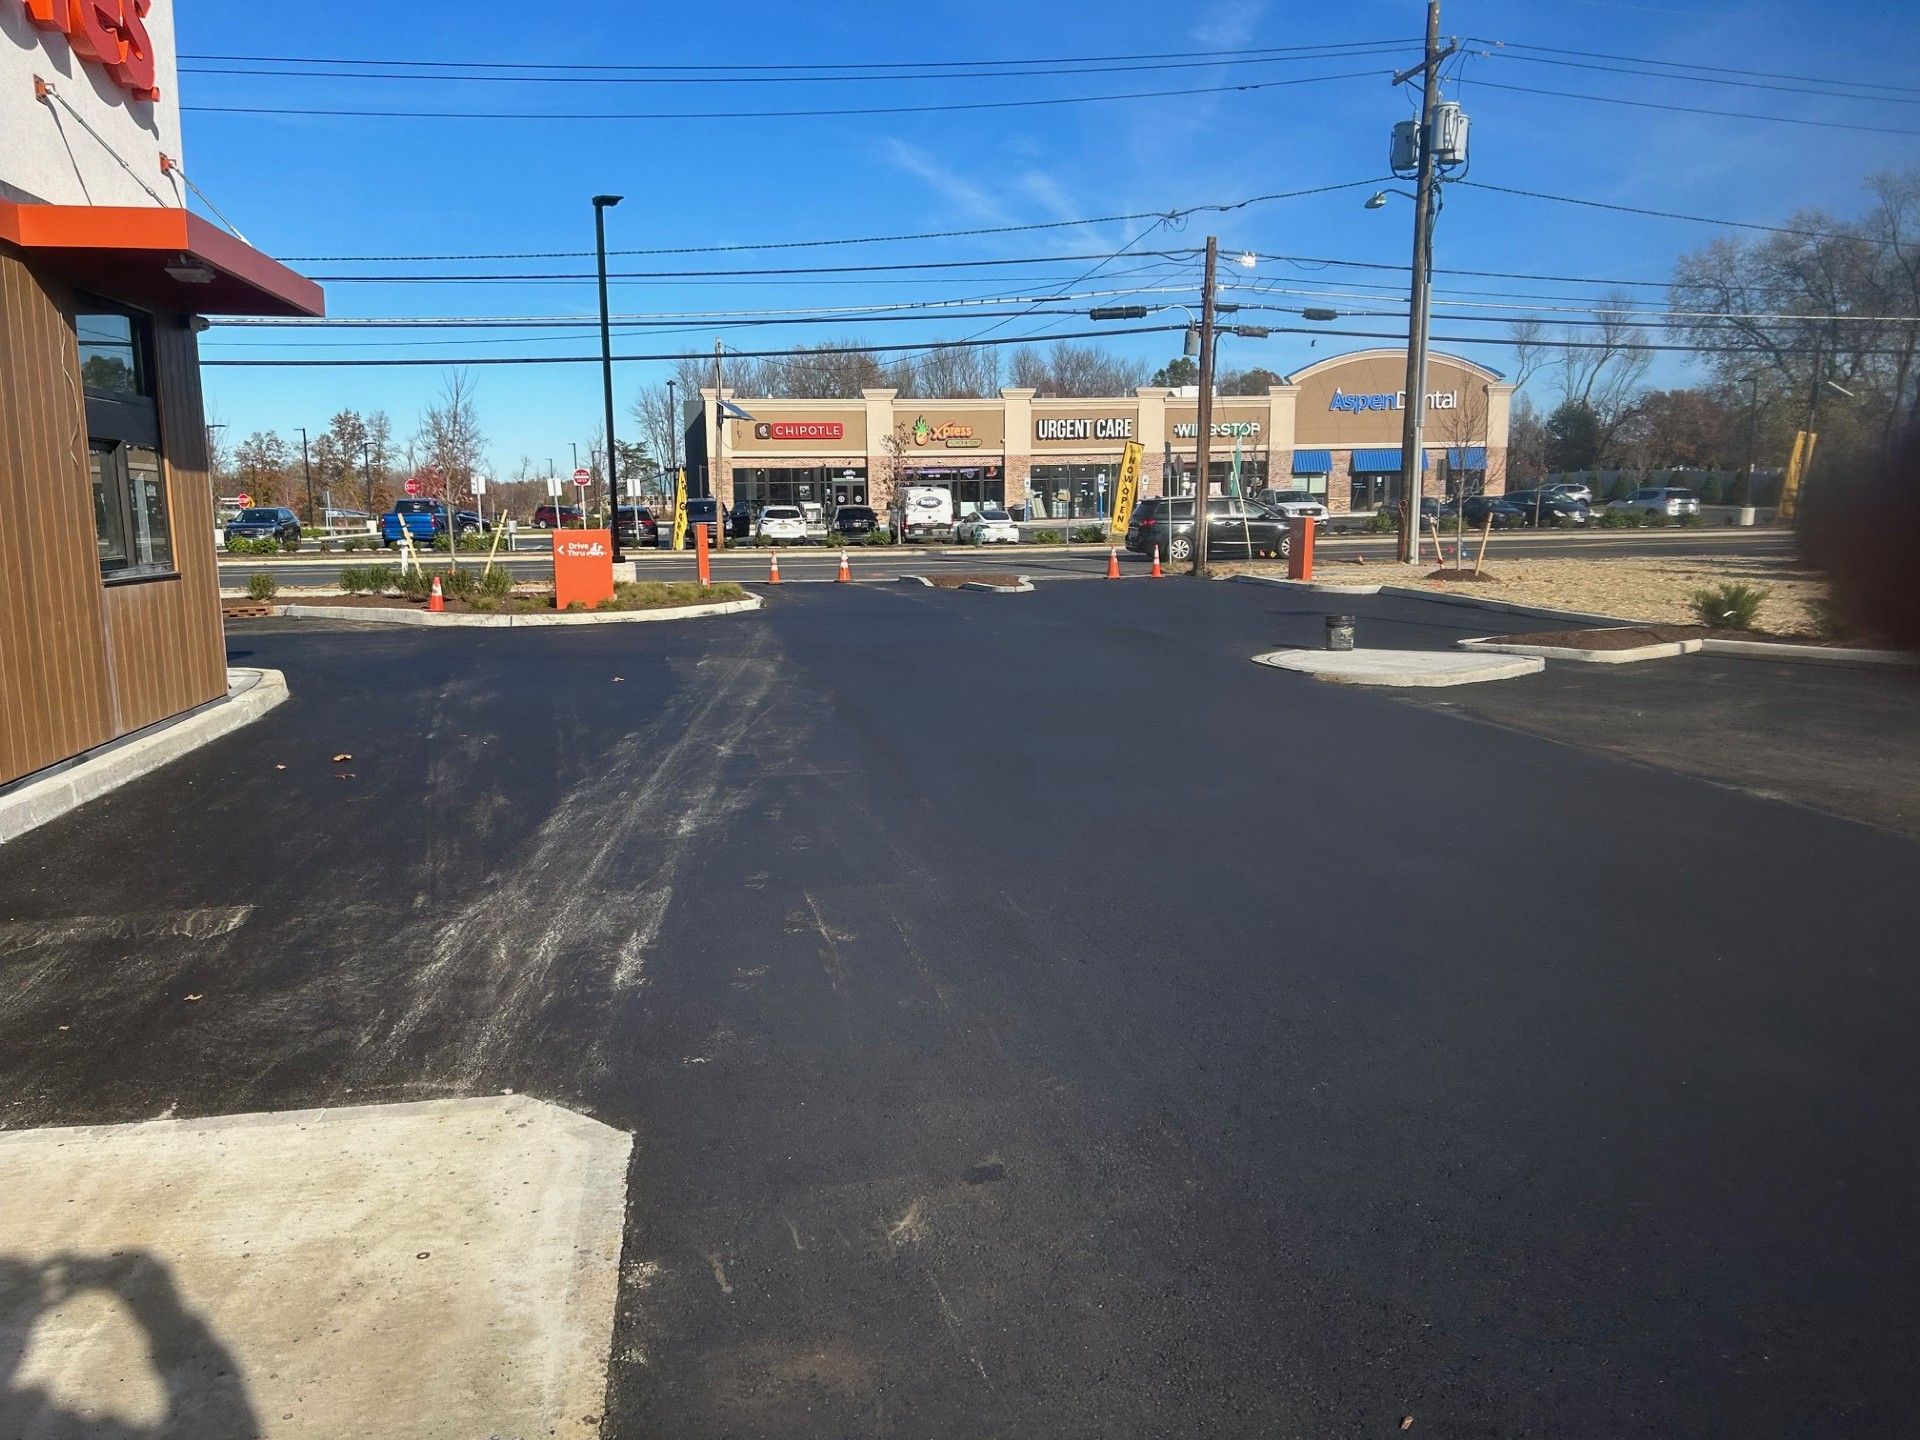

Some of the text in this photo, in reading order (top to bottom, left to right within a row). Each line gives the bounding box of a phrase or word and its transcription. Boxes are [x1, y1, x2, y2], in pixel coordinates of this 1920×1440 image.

[1329, 387, 1457, 414] AspenDntal
[775, 426, 840, 435] CHIPOTLE
[931, 420, 973, 441] Xpress
[1038, 418, 1133, 438] URGENT CARE
[1124, 456, 1136, 483] NOW
[1117, 487, 1130, 523] OPEN
[568, 542, 589, 550] Drive
